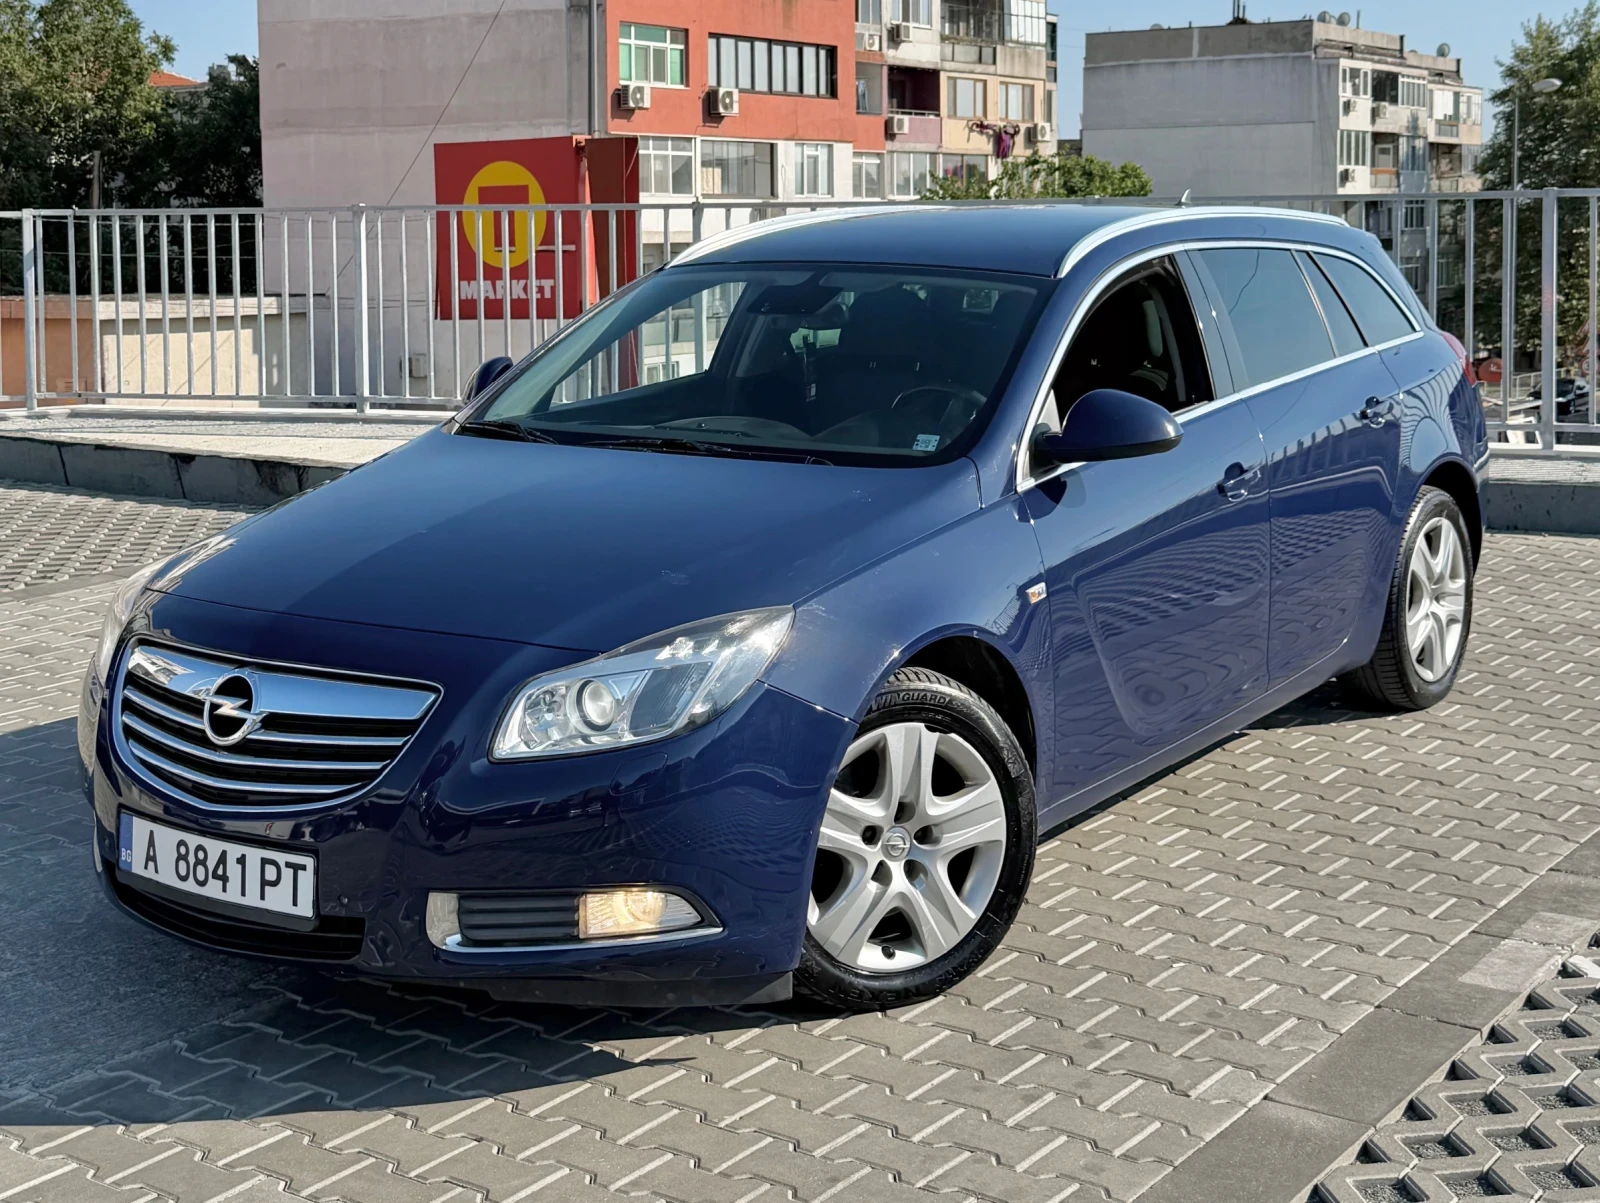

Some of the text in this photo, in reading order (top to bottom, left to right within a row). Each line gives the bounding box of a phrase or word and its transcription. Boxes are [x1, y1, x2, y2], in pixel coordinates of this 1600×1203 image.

[460, 279, 555, 300] MARKET
[121, 847, 132, 863] BG
[144, 829, 159, 874] A
